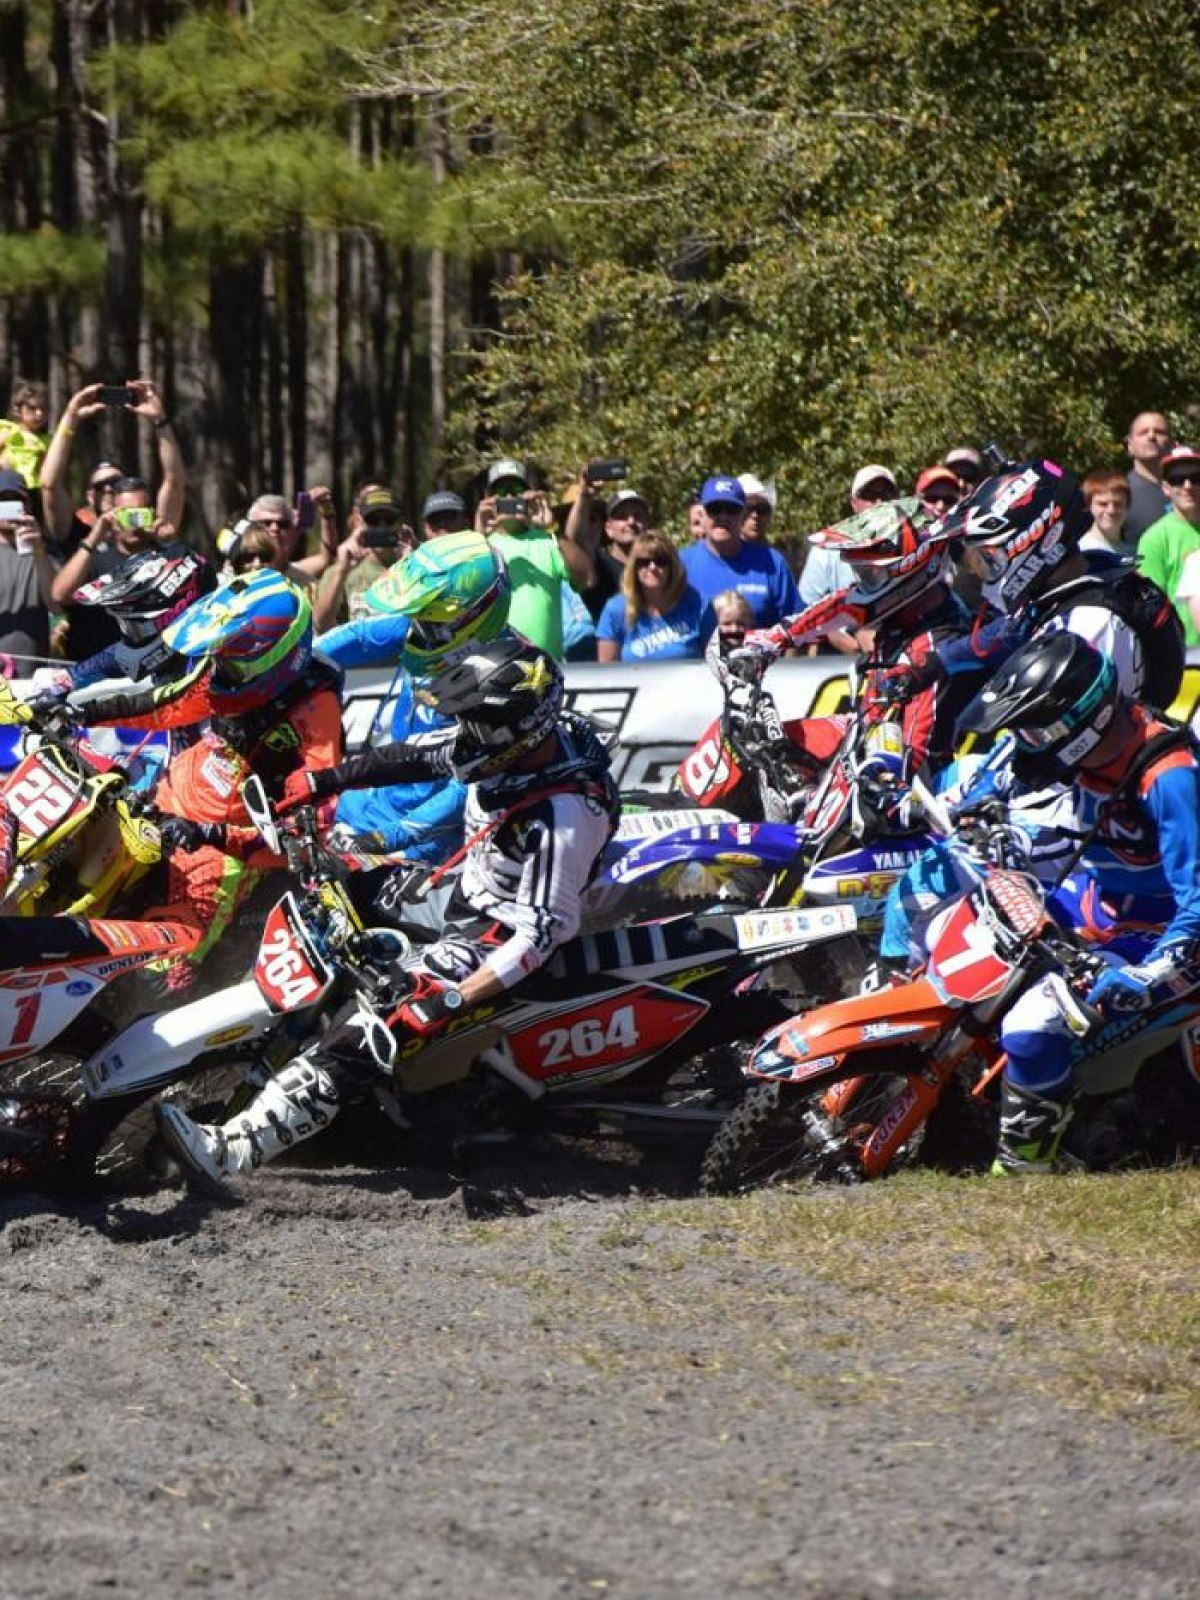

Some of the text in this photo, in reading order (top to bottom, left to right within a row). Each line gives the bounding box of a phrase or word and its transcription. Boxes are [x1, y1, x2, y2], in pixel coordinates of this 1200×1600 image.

[5, 768, 75, 837] 22
[259, 928, 318, 1009] 264
[937, 922, 997, 978] 1
[10, 992, 42, 1047] 1
[538, 1004, 640, 1067] 264
